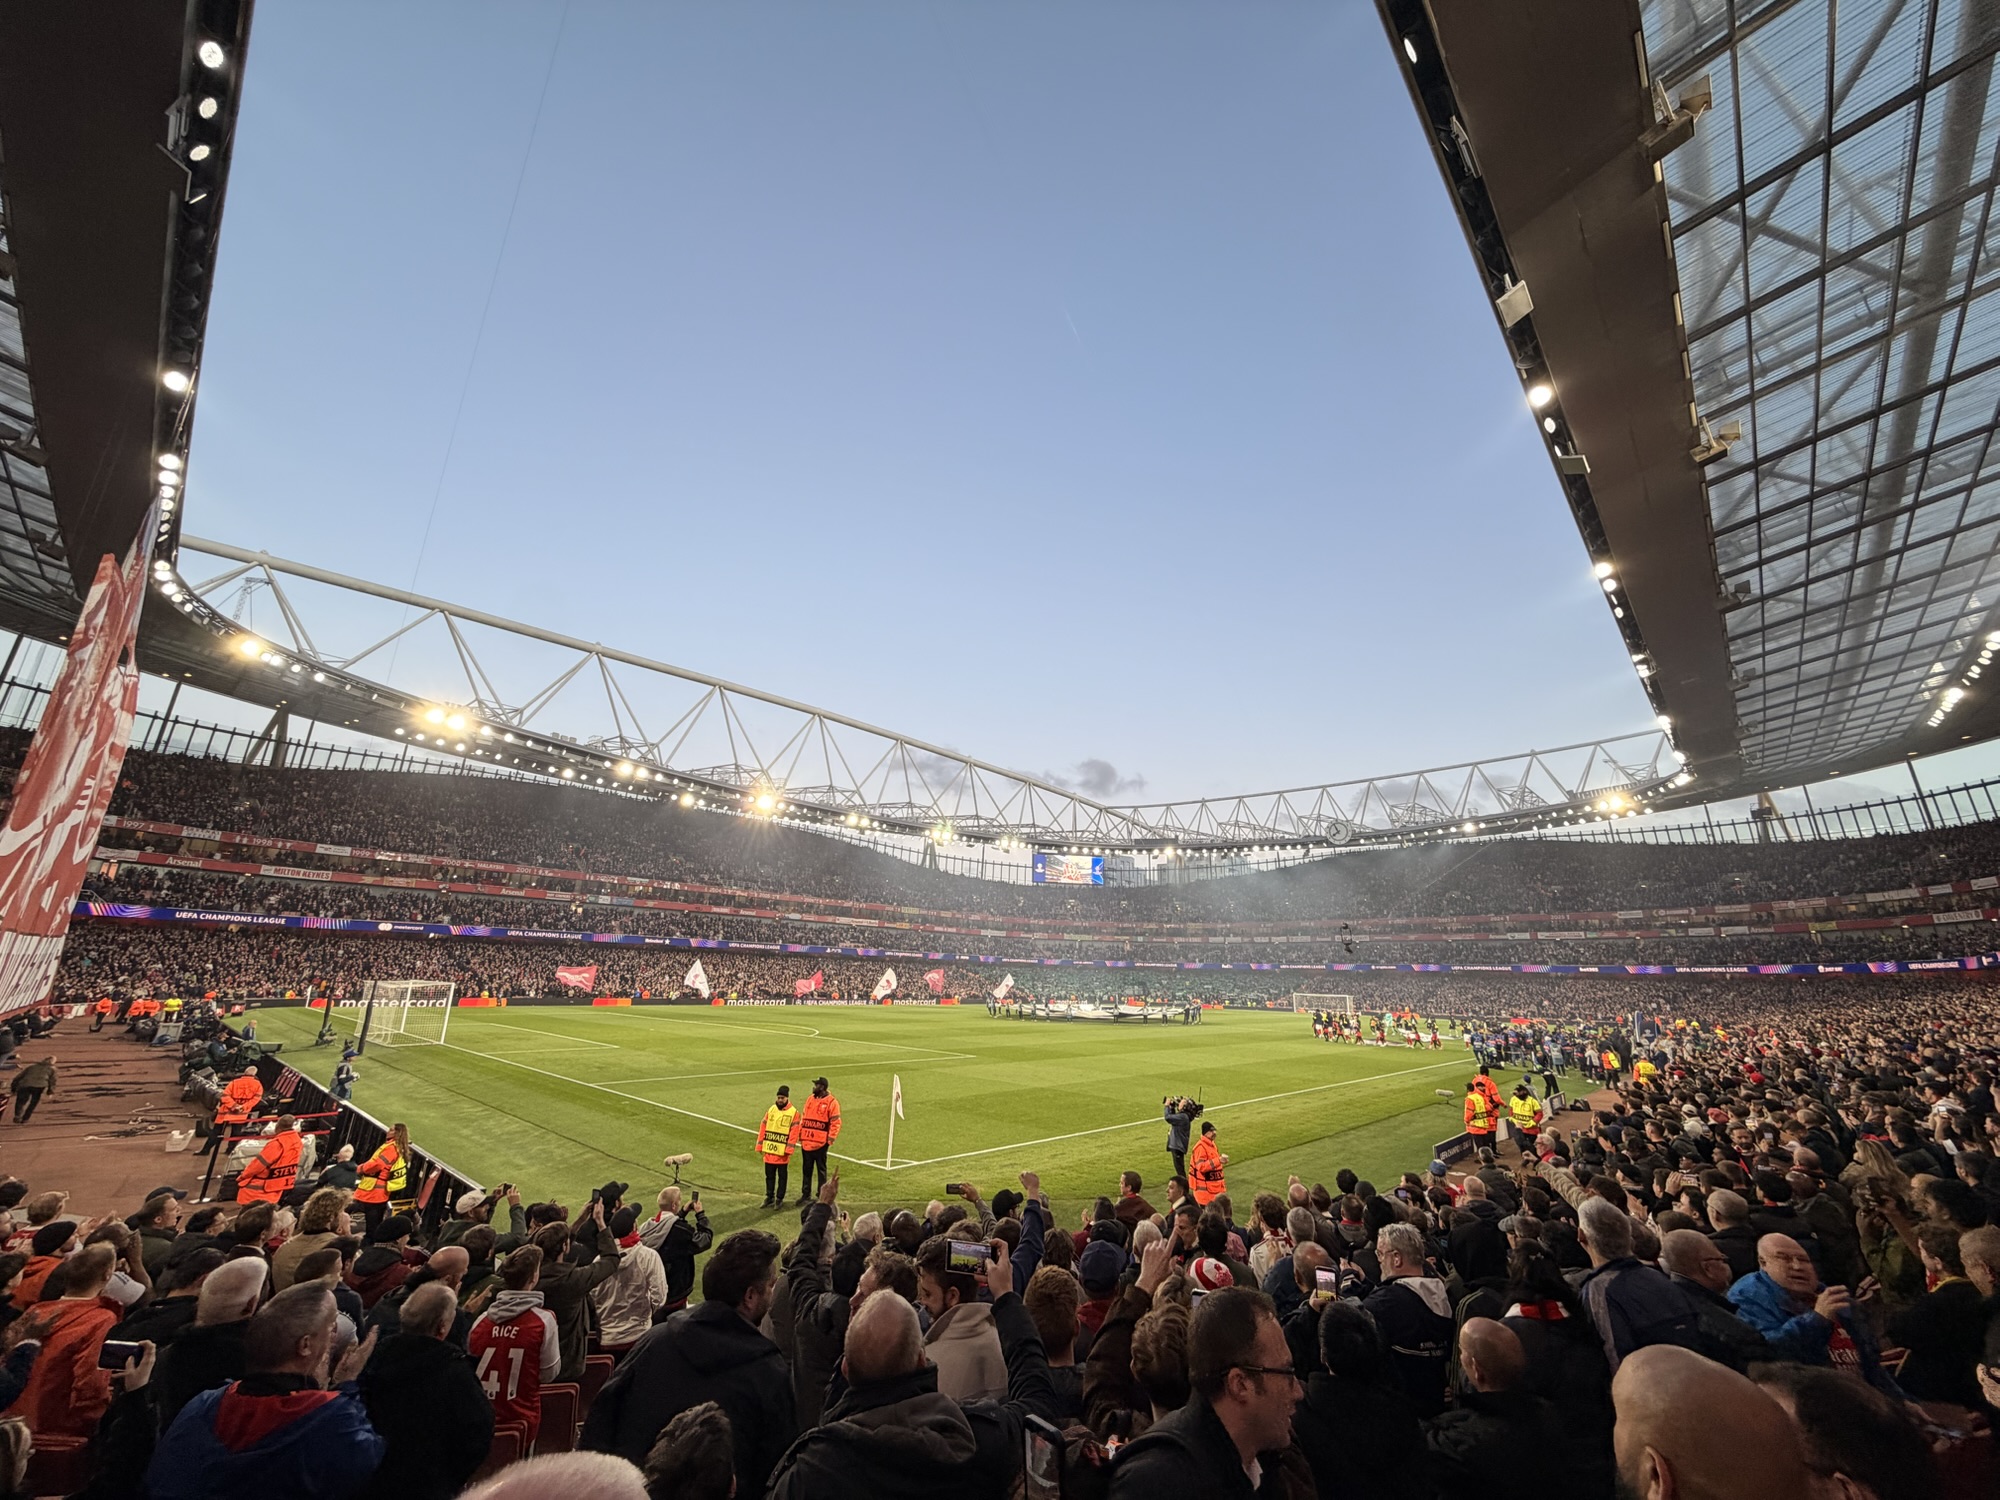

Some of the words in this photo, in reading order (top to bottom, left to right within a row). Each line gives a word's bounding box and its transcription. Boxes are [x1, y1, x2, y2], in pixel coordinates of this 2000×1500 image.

[123, 820, 145, 830] 1997
[252, 838, 273, 847] 1998
[352, 849, 371, 858] 1999
[165, 856, 202, 867] Arsenal
[442, 859, 461, 867] 2000
[476, 862, 505, 871] MALAYSIA
[515, 866, 532, 874] 2001
[273, 867, 300, 877] MILTON
[301, 870, 330, 879] KEYNES
[500, 888, 525, 896] Arsenal
[176, 911, 198, 920] UEFA
[200, 913, 252, 923] CHAMPIONS
[253, 916, 286, 925] LEAGUE
[560, 932, 582, 940] LEAGUE
[340, 998, 447, 1008] mastercard
[492, 1325, 519, 1339] RICE
[475, 1347, 524, 1400] 41
